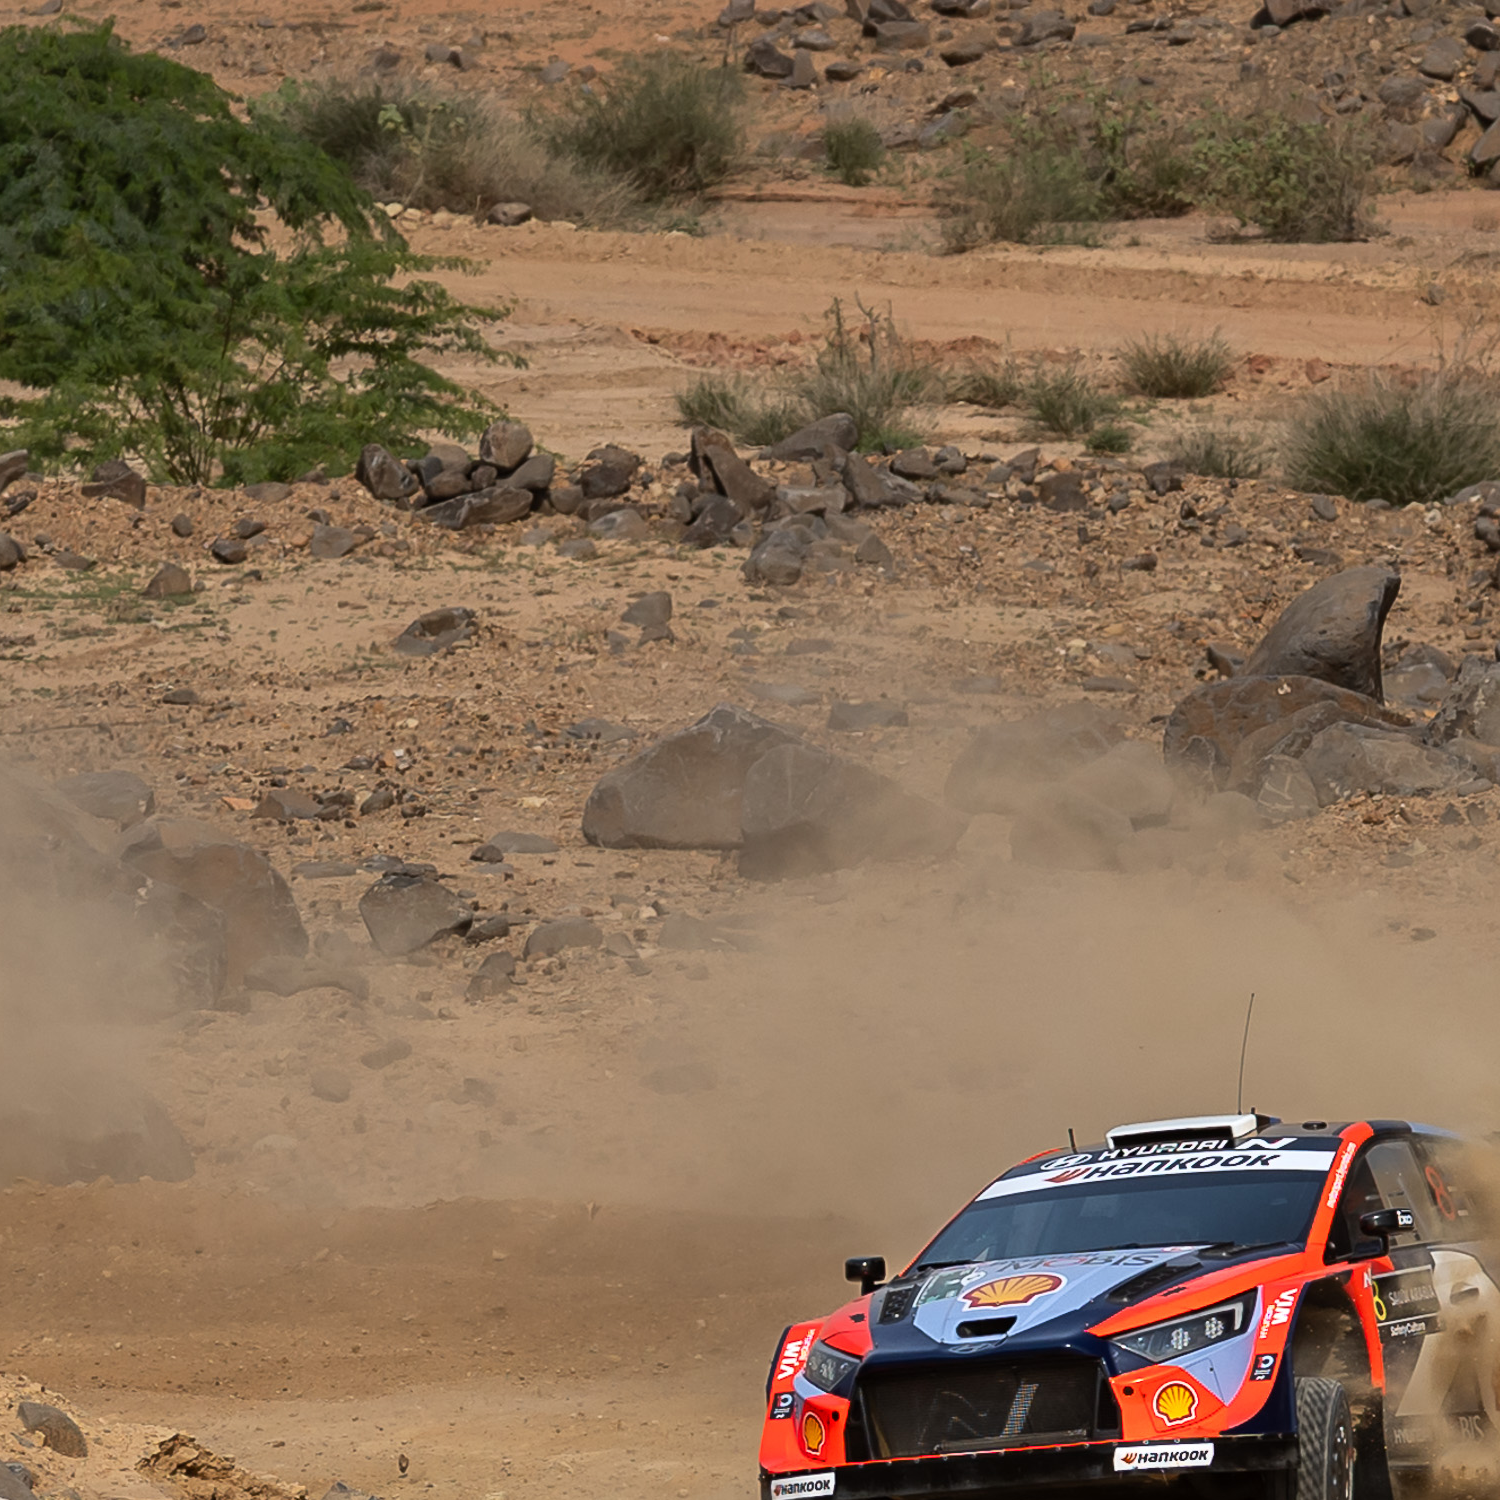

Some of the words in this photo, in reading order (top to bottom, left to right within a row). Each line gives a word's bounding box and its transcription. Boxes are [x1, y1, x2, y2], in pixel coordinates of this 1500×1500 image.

[1098, 1139, 1229, 1161] HYUNDAI
[1425, 1165, 1455, 1219] 8
[998, 1253, 1159, 1272] MOBIS
